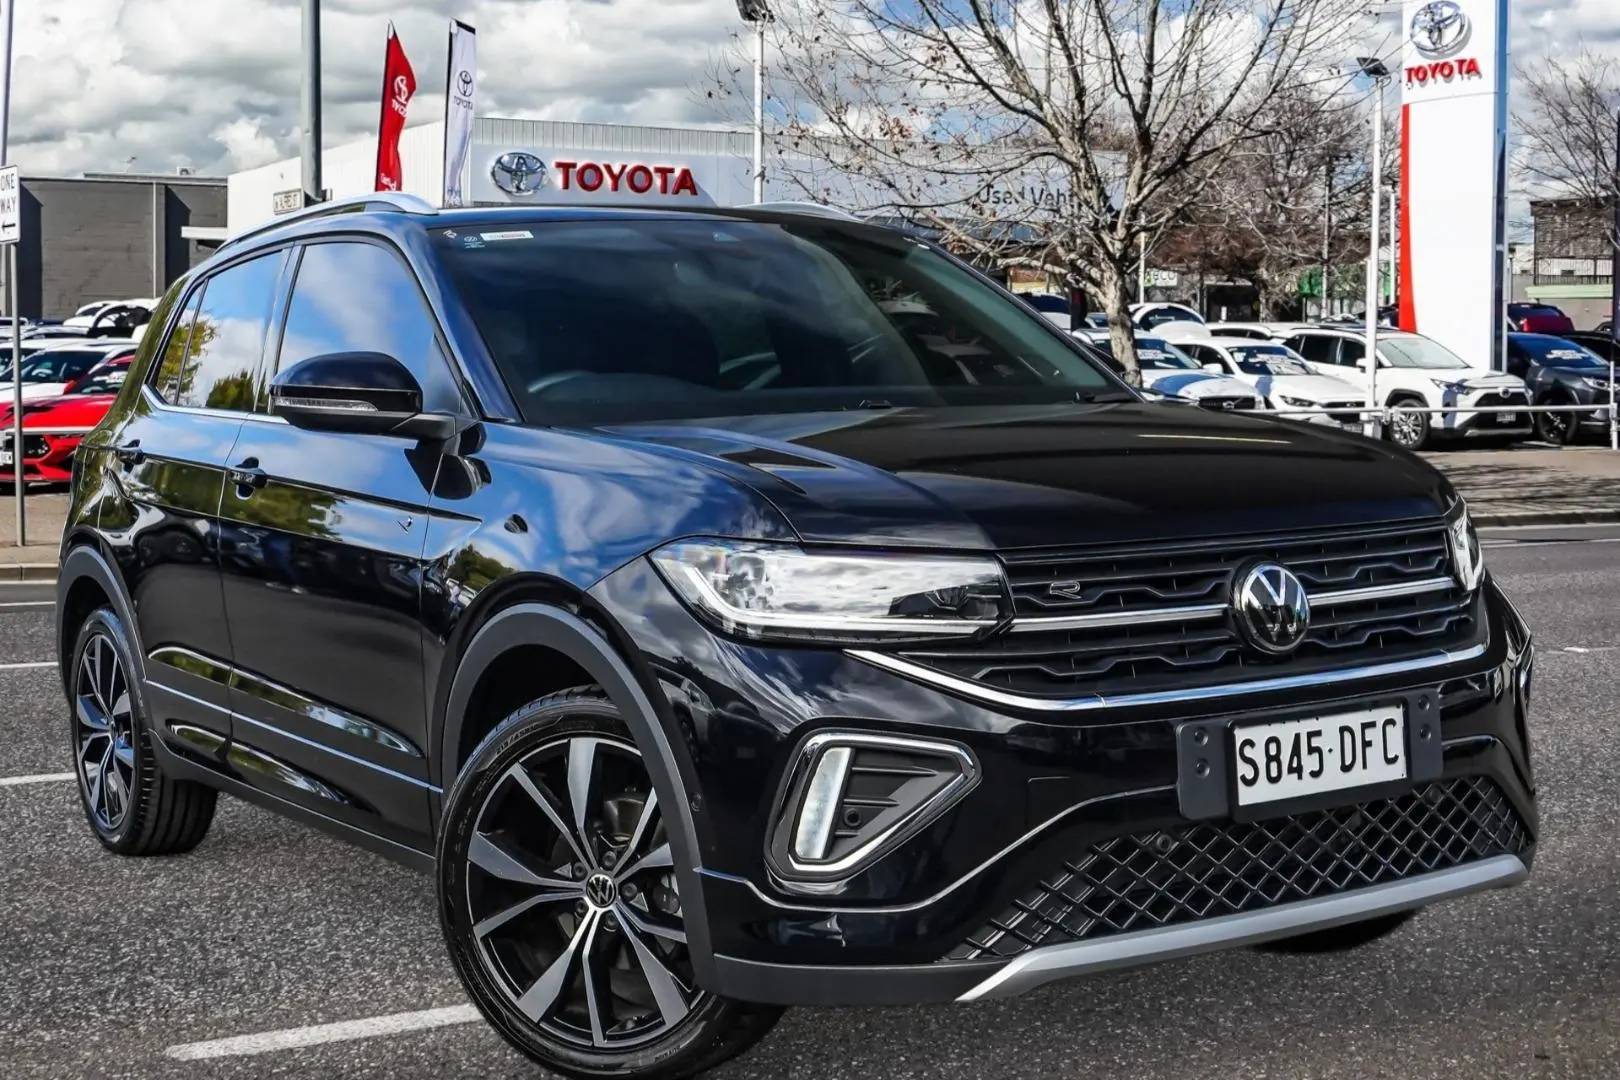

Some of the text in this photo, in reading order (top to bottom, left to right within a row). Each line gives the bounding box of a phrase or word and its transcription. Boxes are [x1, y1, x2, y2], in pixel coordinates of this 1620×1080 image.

[1404, 58, 1481, 83] TOYOTA
[453, 95, 474, 110] TOYOTA
[555, 161, 698, 196] TOYOTA
[0, 196, 16, 214] WAY
